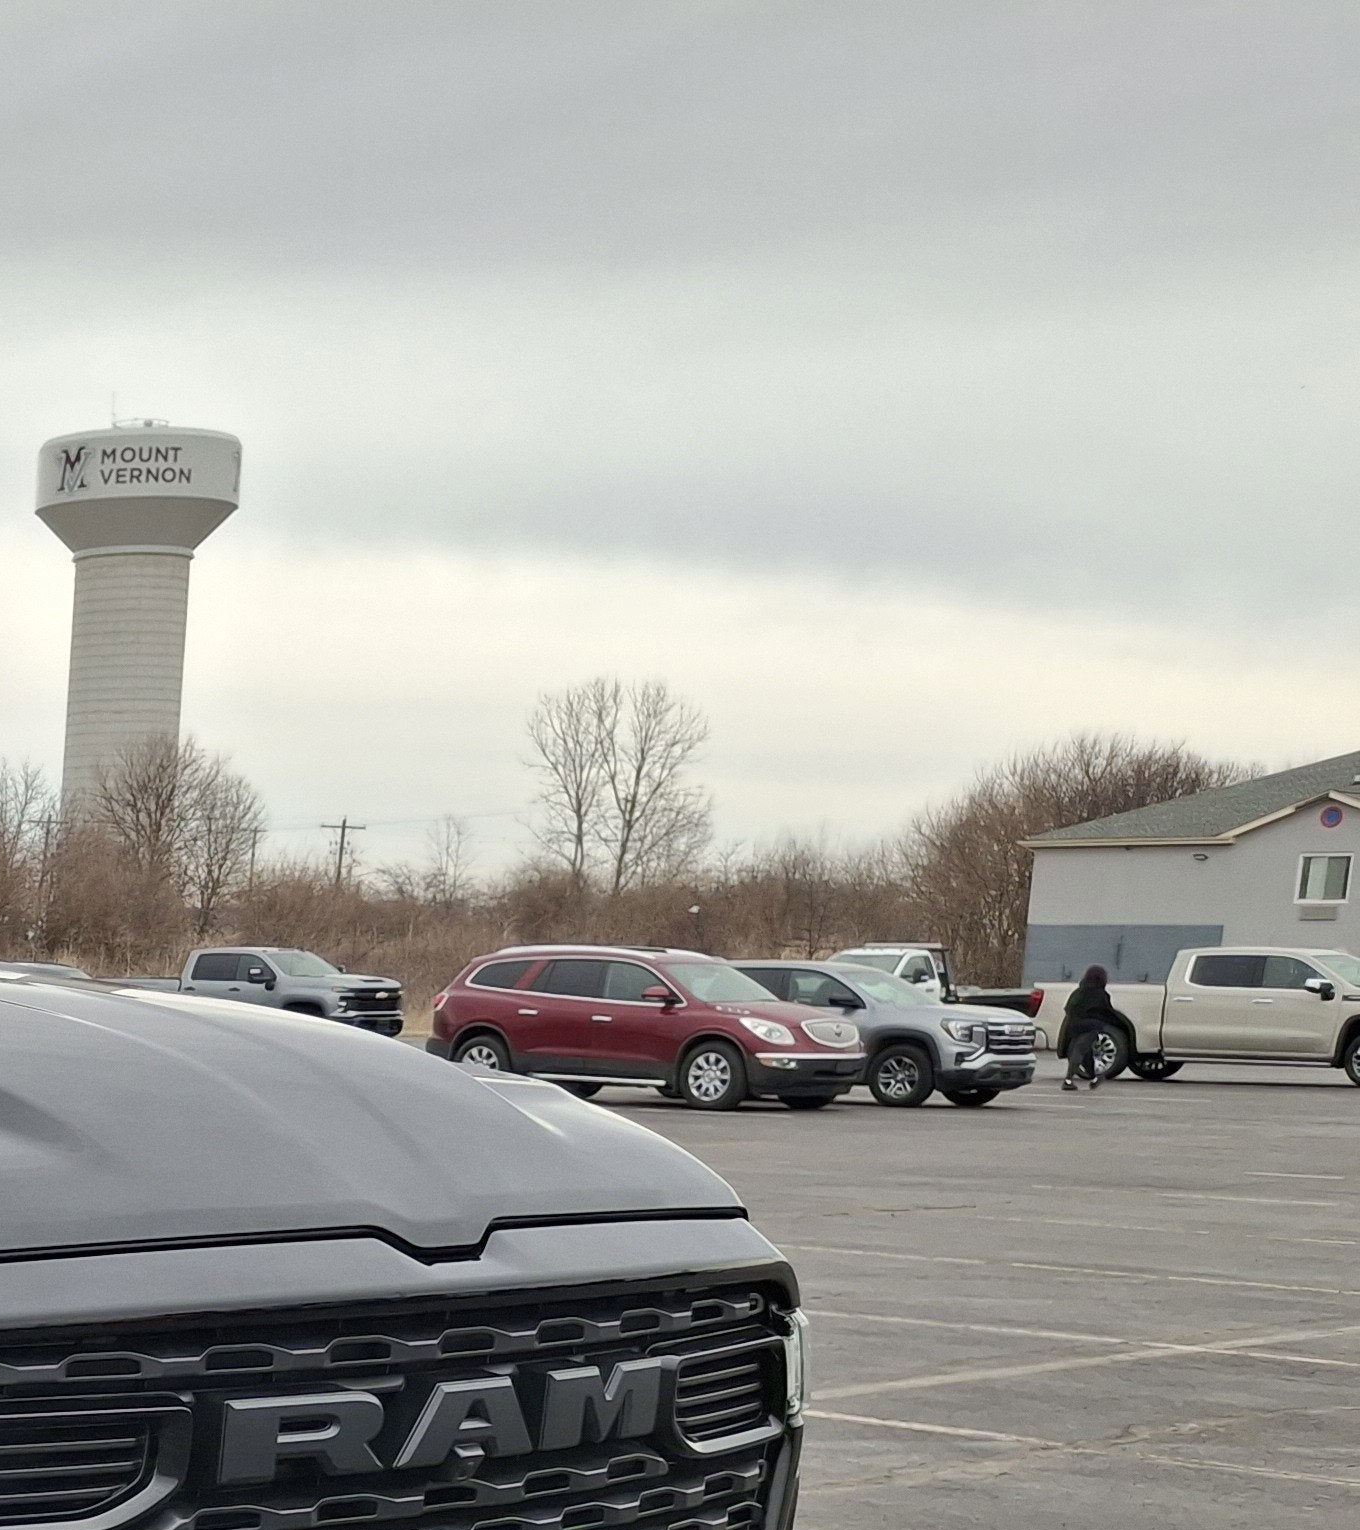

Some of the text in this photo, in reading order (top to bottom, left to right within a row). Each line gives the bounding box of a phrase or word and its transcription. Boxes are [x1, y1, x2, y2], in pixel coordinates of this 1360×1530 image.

[100, 446, 183, 464] MOUNT
[100, 467, 192, 485] VERNON
[218, 1358, 662, 1484] RAM
